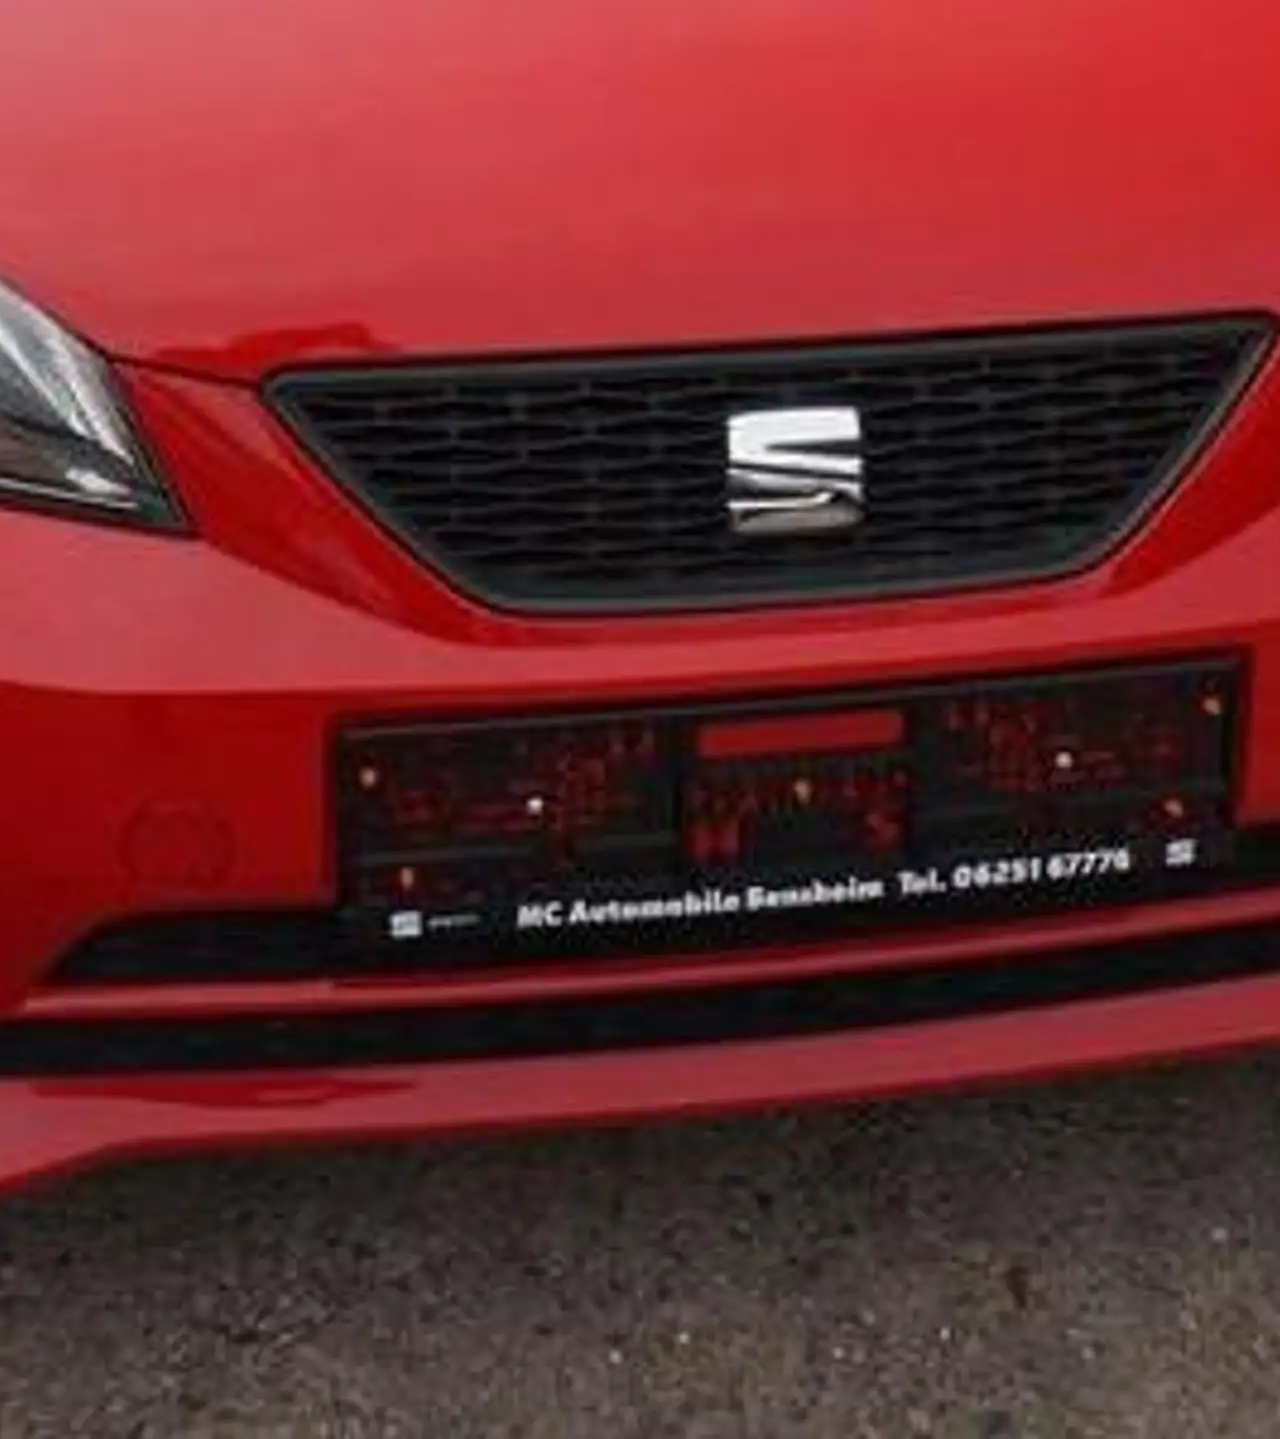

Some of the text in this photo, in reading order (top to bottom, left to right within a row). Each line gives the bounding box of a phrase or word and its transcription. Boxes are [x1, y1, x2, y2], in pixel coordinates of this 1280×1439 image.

[517, 899, 563, 928] MC
[569, 888, 740, 925] Automobile
[897, 867, 947, 895] Tel.
